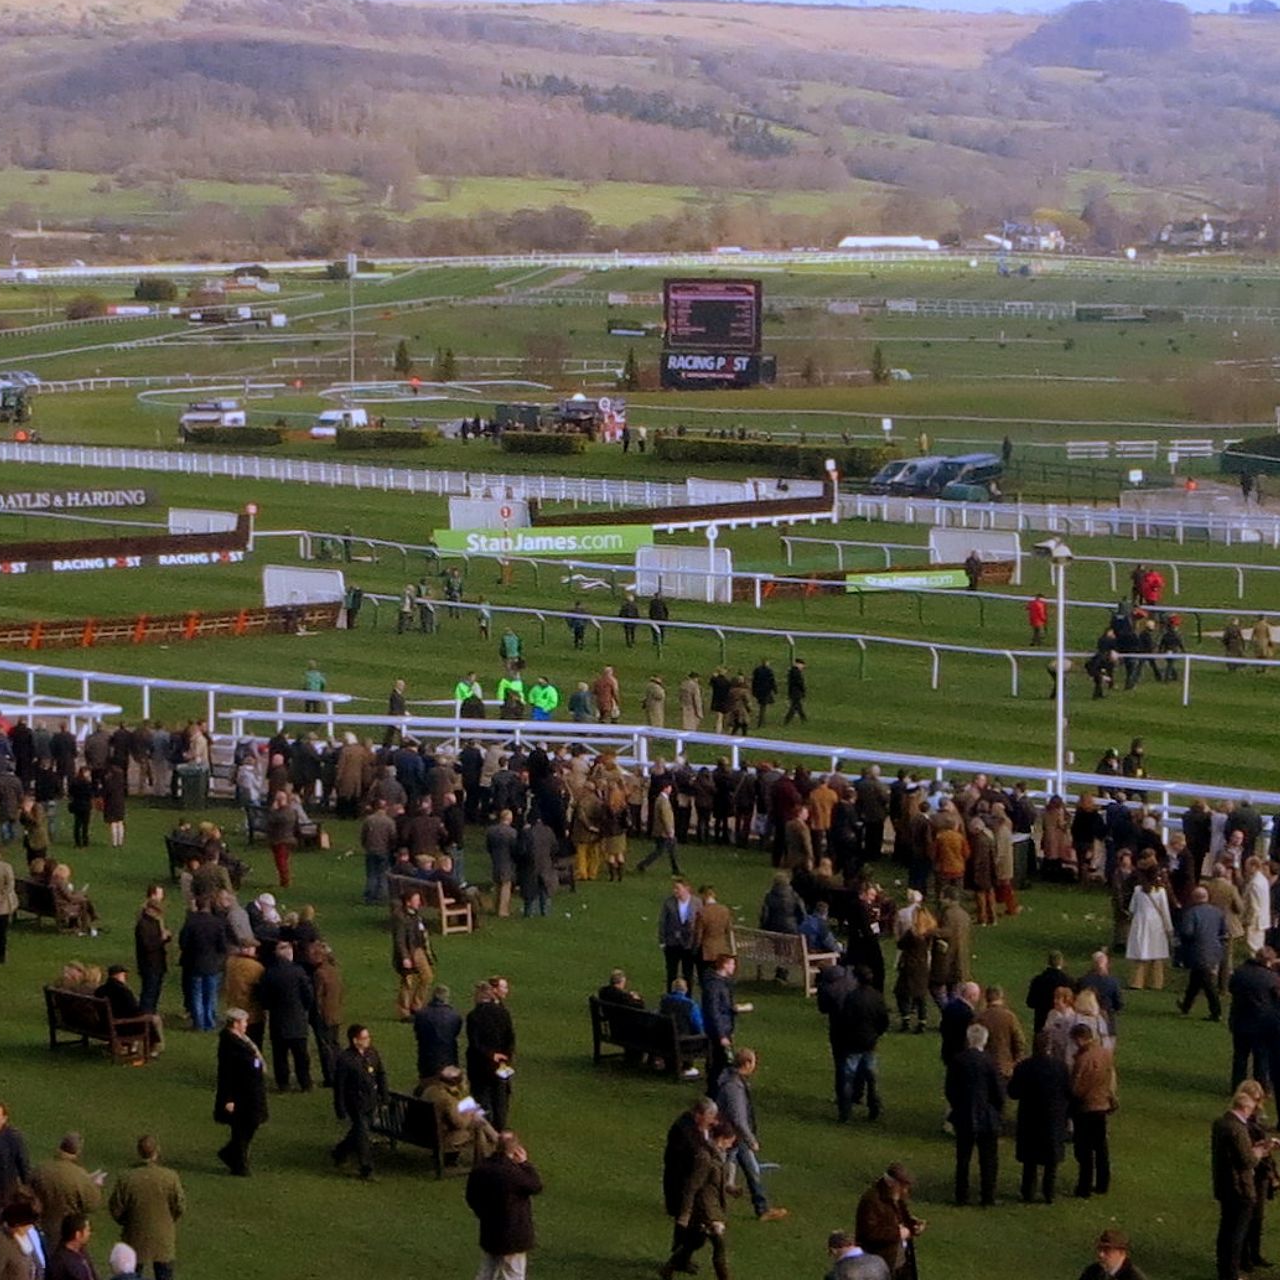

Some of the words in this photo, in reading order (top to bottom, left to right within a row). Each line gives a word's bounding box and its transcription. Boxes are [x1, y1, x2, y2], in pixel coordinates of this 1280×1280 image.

[667, 355, 715, 370] RACING
[716, 355, 750, 371] POST
[53, 495, 65, 507] &
[66, 490, 146, 507] HARDING
[467, 532, 623, 554] StanJames.com
[52, 559, 105, 571] RACING
[107, 556, 141, 569] POST
[159, 552, 210, 565] RACING
[212, 550, 244, 563] POST
